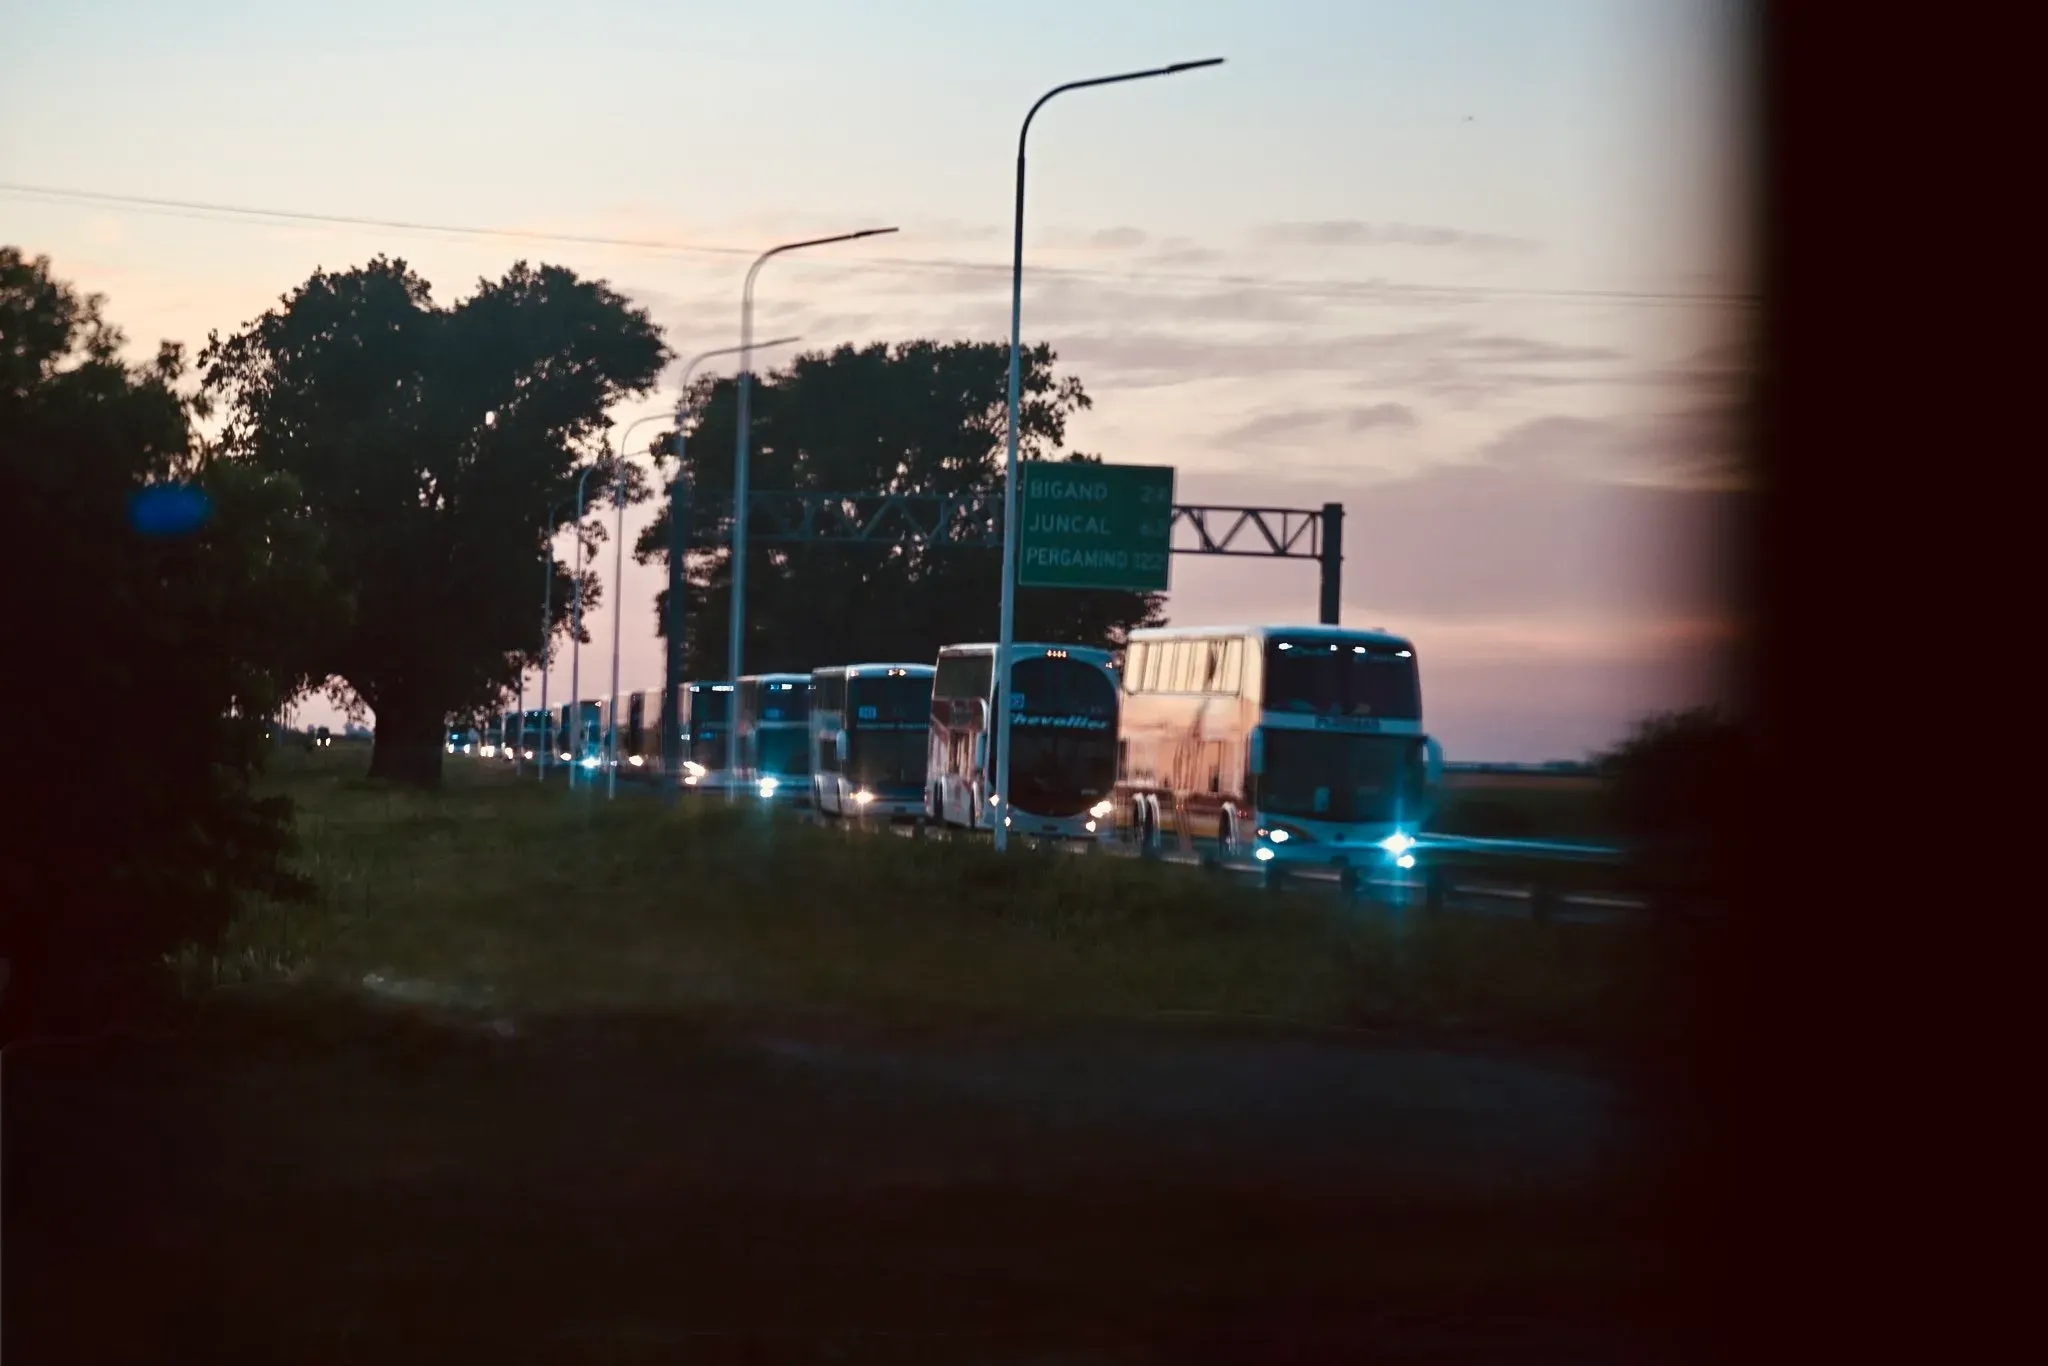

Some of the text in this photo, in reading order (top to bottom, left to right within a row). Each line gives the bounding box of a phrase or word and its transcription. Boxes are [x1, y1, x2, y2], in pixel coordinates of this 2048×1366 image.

[1030, 479, 1108, 502] BIGAND
[1028, 512, 1112, 536] JUNCAL
[1026, 547, 1128, 570] PERGAMINO
[1011, 713, 1109, 730] hevallier
